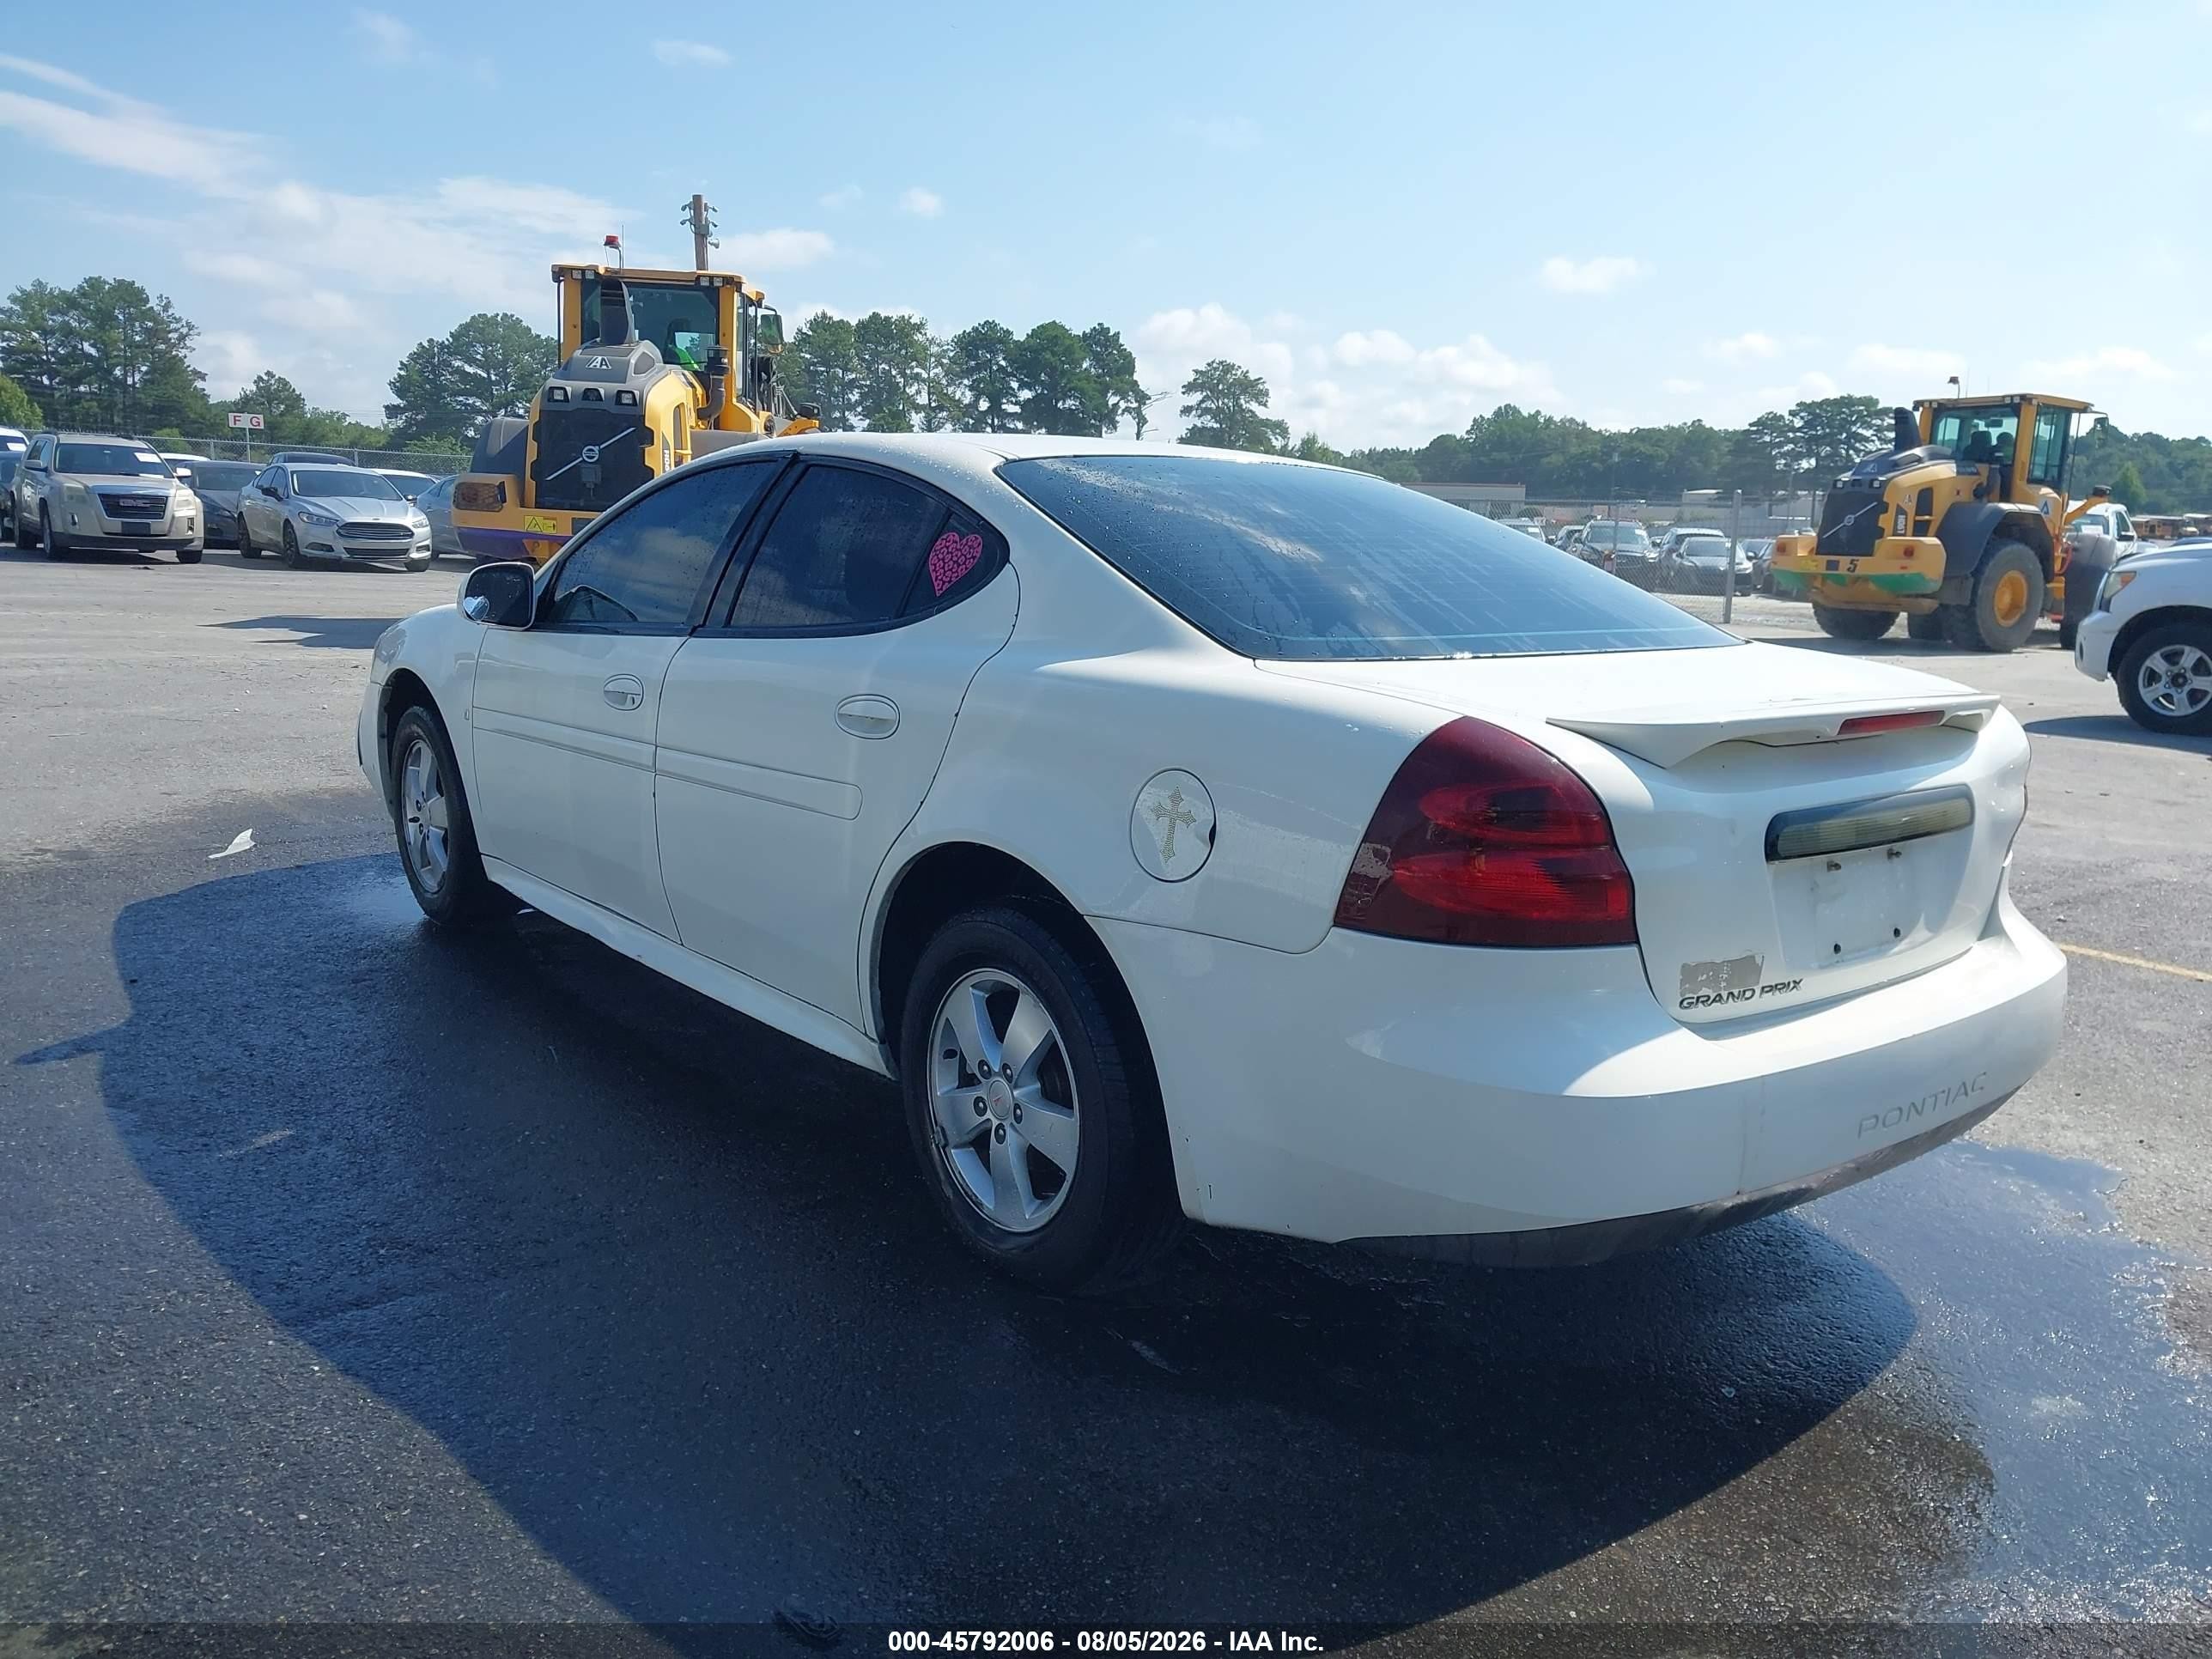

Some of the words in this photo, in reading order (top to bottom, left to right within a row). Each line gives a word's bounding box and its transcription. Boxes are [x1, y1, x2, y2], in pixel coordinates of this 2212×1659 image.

[233, 415, 242, 426] F
[249, 416, 261, 428] G
[1846, 558, 1860, 574] 5
[1678, 987, 1757, 1011] GRAND
[1759, 978, 1804, 999] PRIX
[1856, 1071, 1988, 1139] PONTIAC
